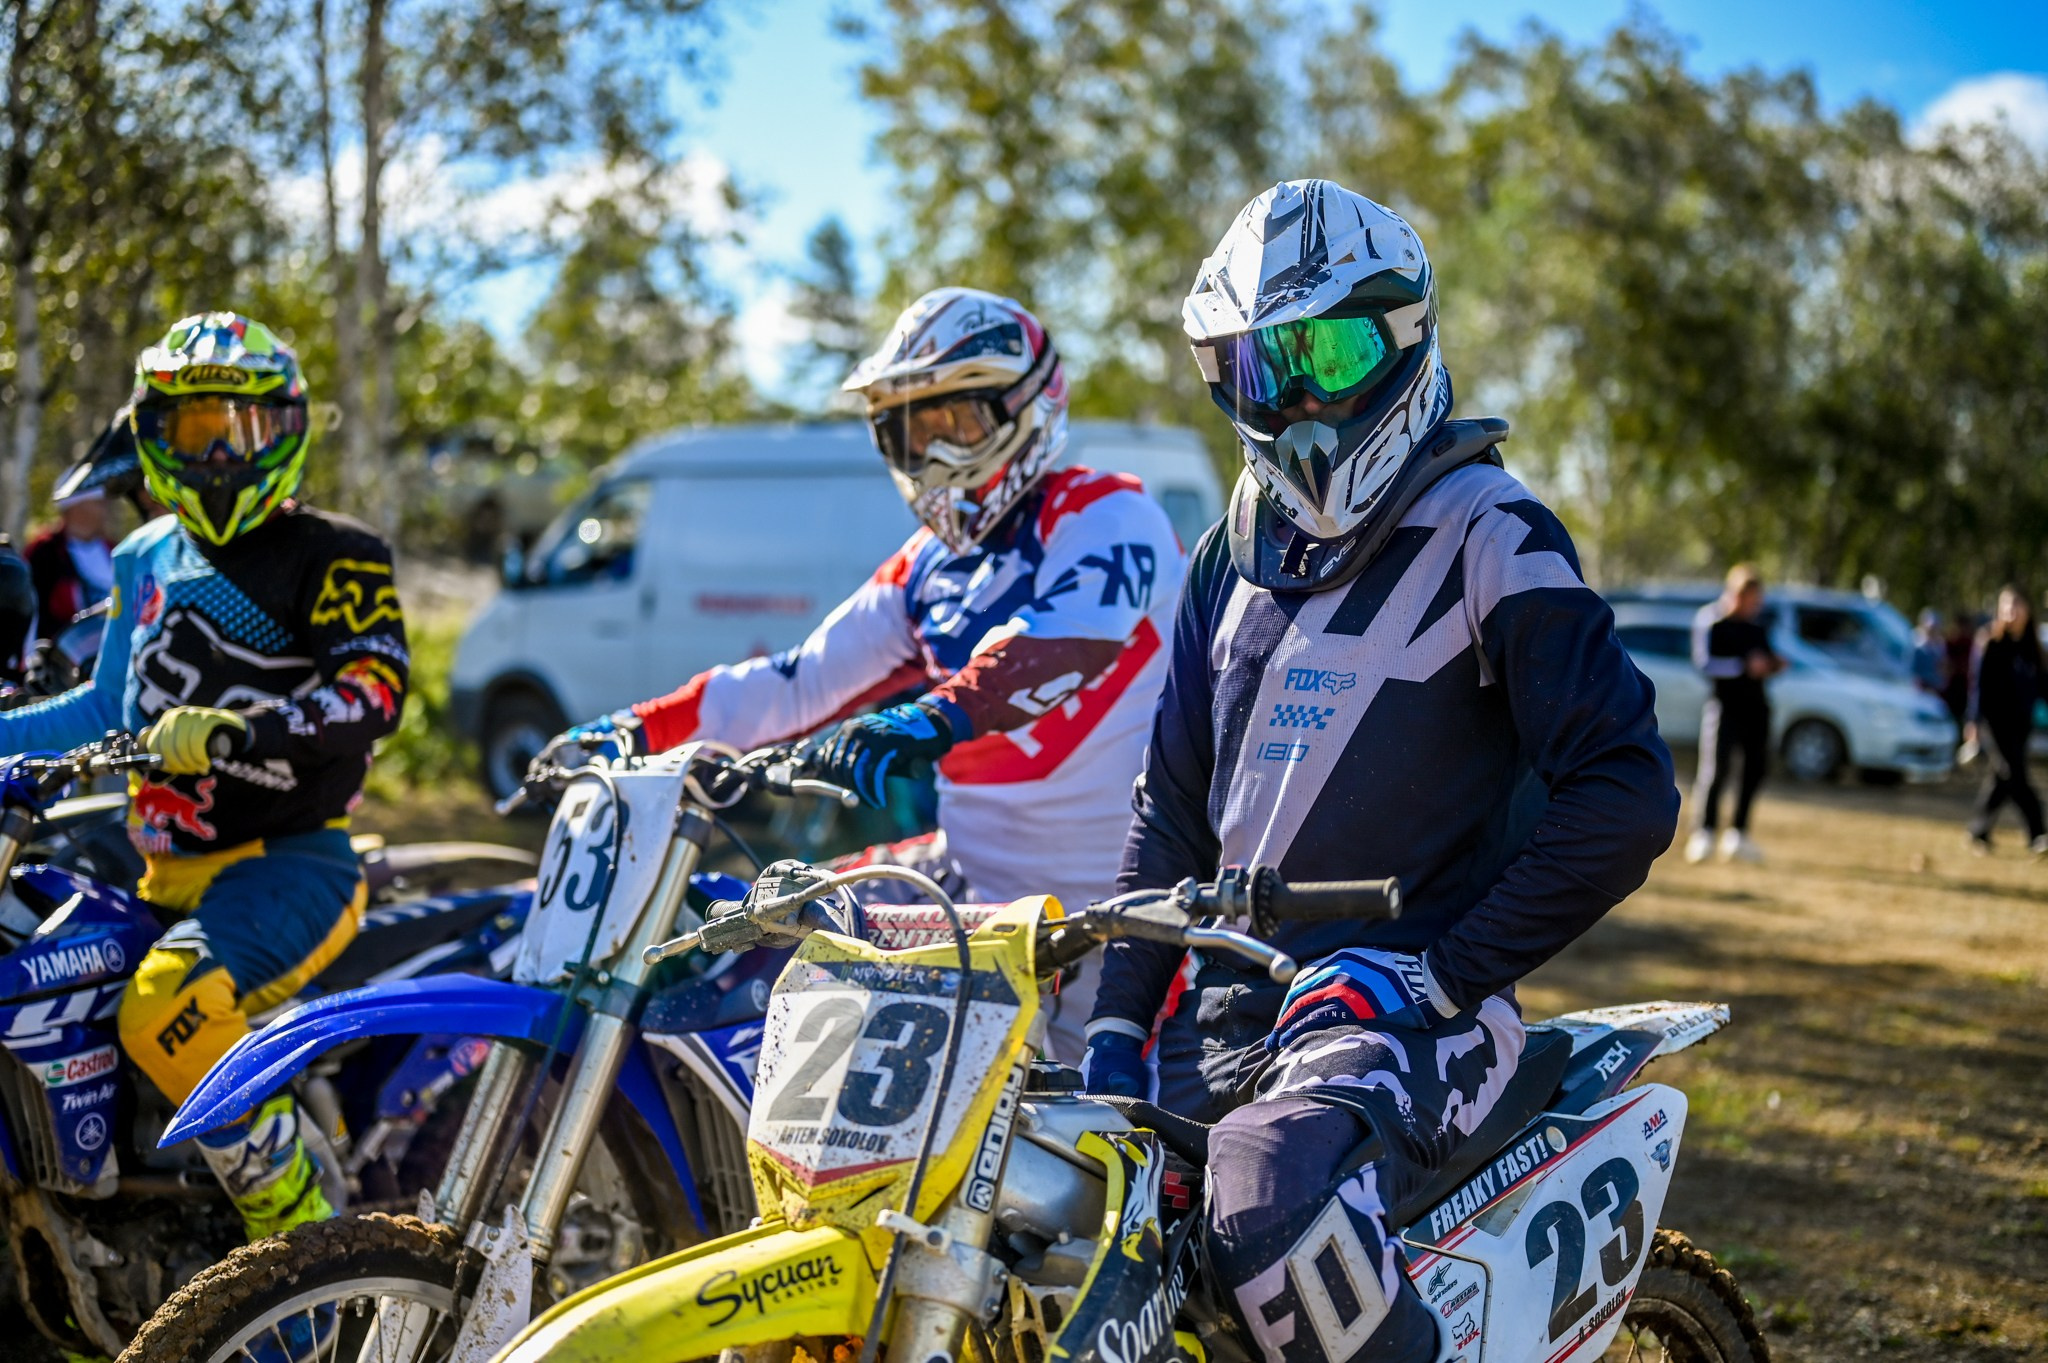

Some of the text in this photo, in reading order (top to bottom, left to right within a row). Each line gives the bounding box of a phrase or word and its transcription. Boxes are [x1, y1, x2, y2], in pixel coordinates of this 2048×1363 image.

[1320, 536, 1357, 578] EVS
[1284, 668, 1329, 692] FOX
[1257, 742, 1310, 762] 180
[20, 943, 105, 986] YAMAHA
[156, 995, 208, 1057] FOX
[66, 1050, 116, 1082] Castrol
[766, 998, 950, 1127] 23
[62, 1082, 118, 1111] Twin Air
[1642, 1108, 1666, 1136] AMA
[779, 1125, 892, 1154] ARTEM SOKOLOV
[1430, 1133, 1550, 1241] FREAKY FAST!
[1525, 1156, 1645, 1345] 23
[696, 1255, 843, 1328] Sycuan
[1456, 1327, 1480, 1351] FOX
[1578, 1325, 1586, 1344] A
